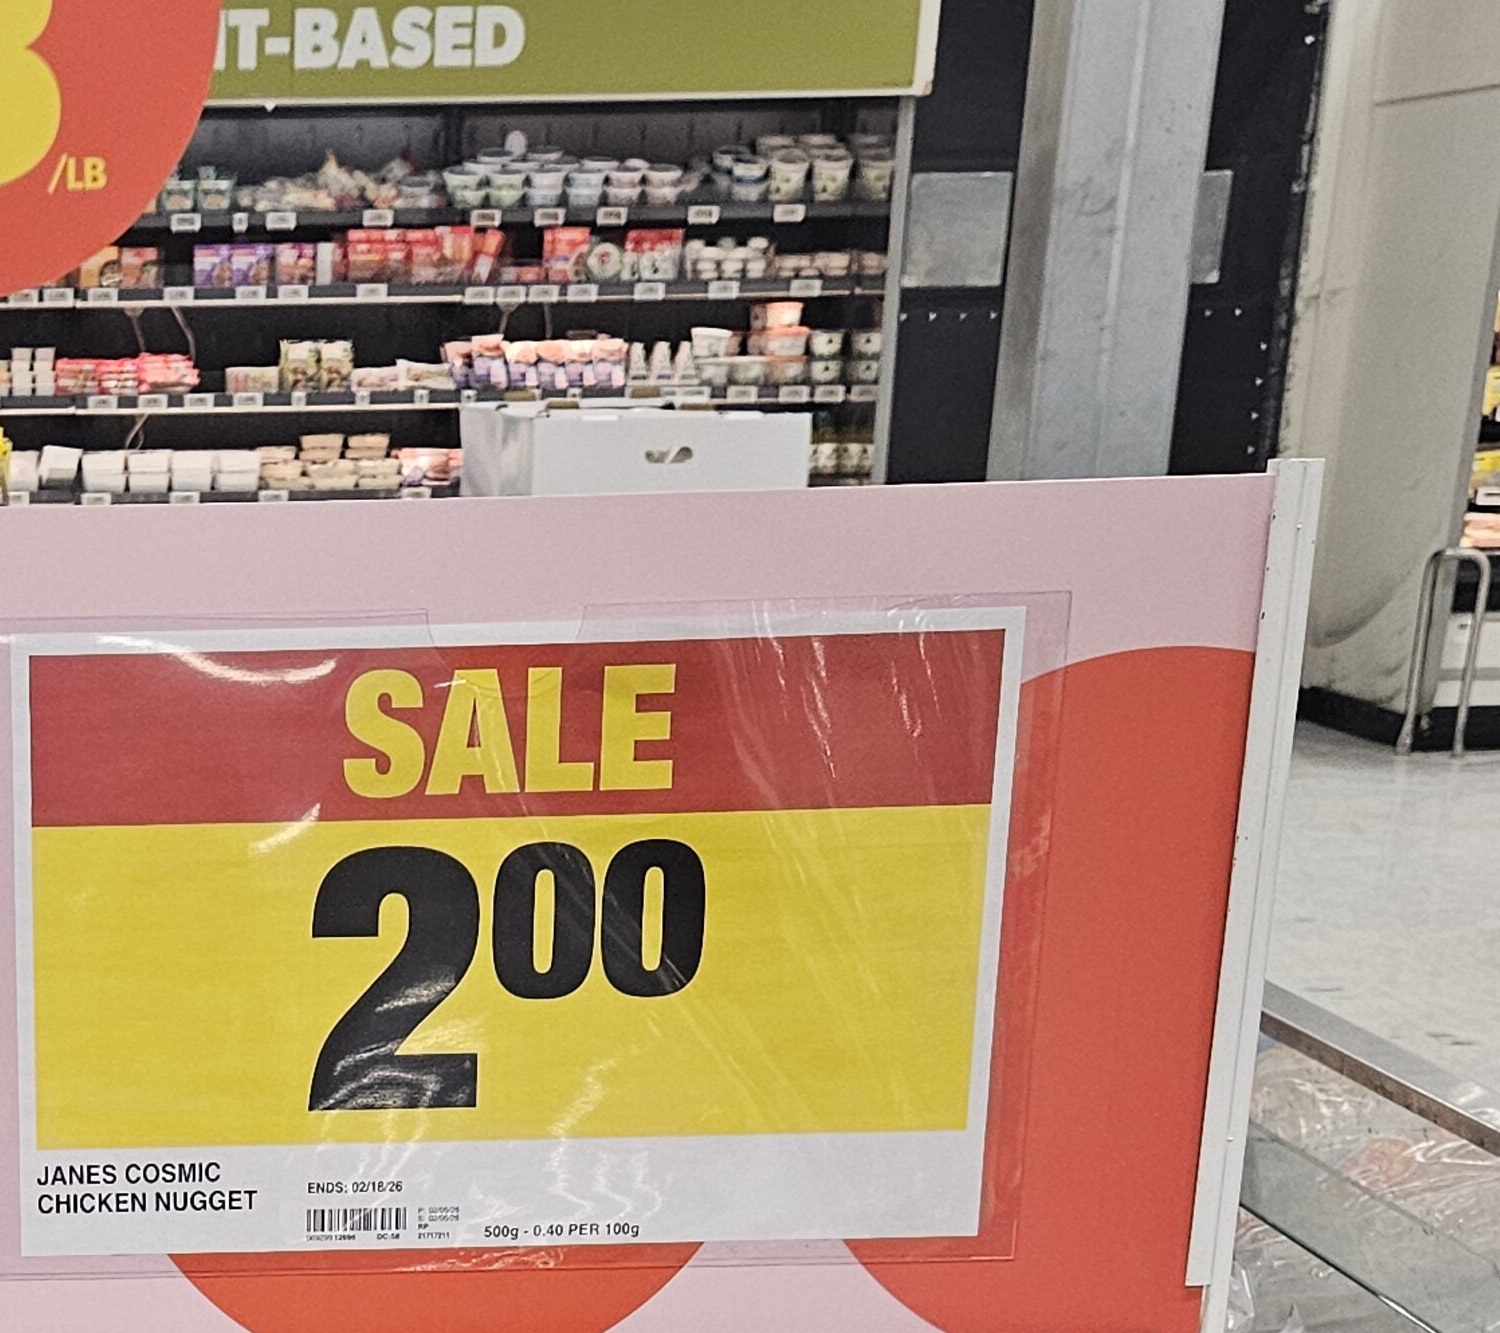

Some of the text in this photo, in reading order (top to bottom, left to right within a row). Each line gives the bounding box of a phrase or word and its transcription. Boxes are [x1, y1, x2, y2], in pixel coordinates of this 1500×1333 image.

[216, 6, 526, 70] T-BASED
[48, 155, 107, 193] /LB
[344, 663, 676, 799] SALE
[37, 1162, 221, 1186] JANES COSMIC
[308, 1180, 403, 1194] ENDS: 02/18/26
[37, 1190, 258, 1214] CHICKEN NUGGET
[483, 1222, 640, 1241] 500g 0.40 PER 100g
